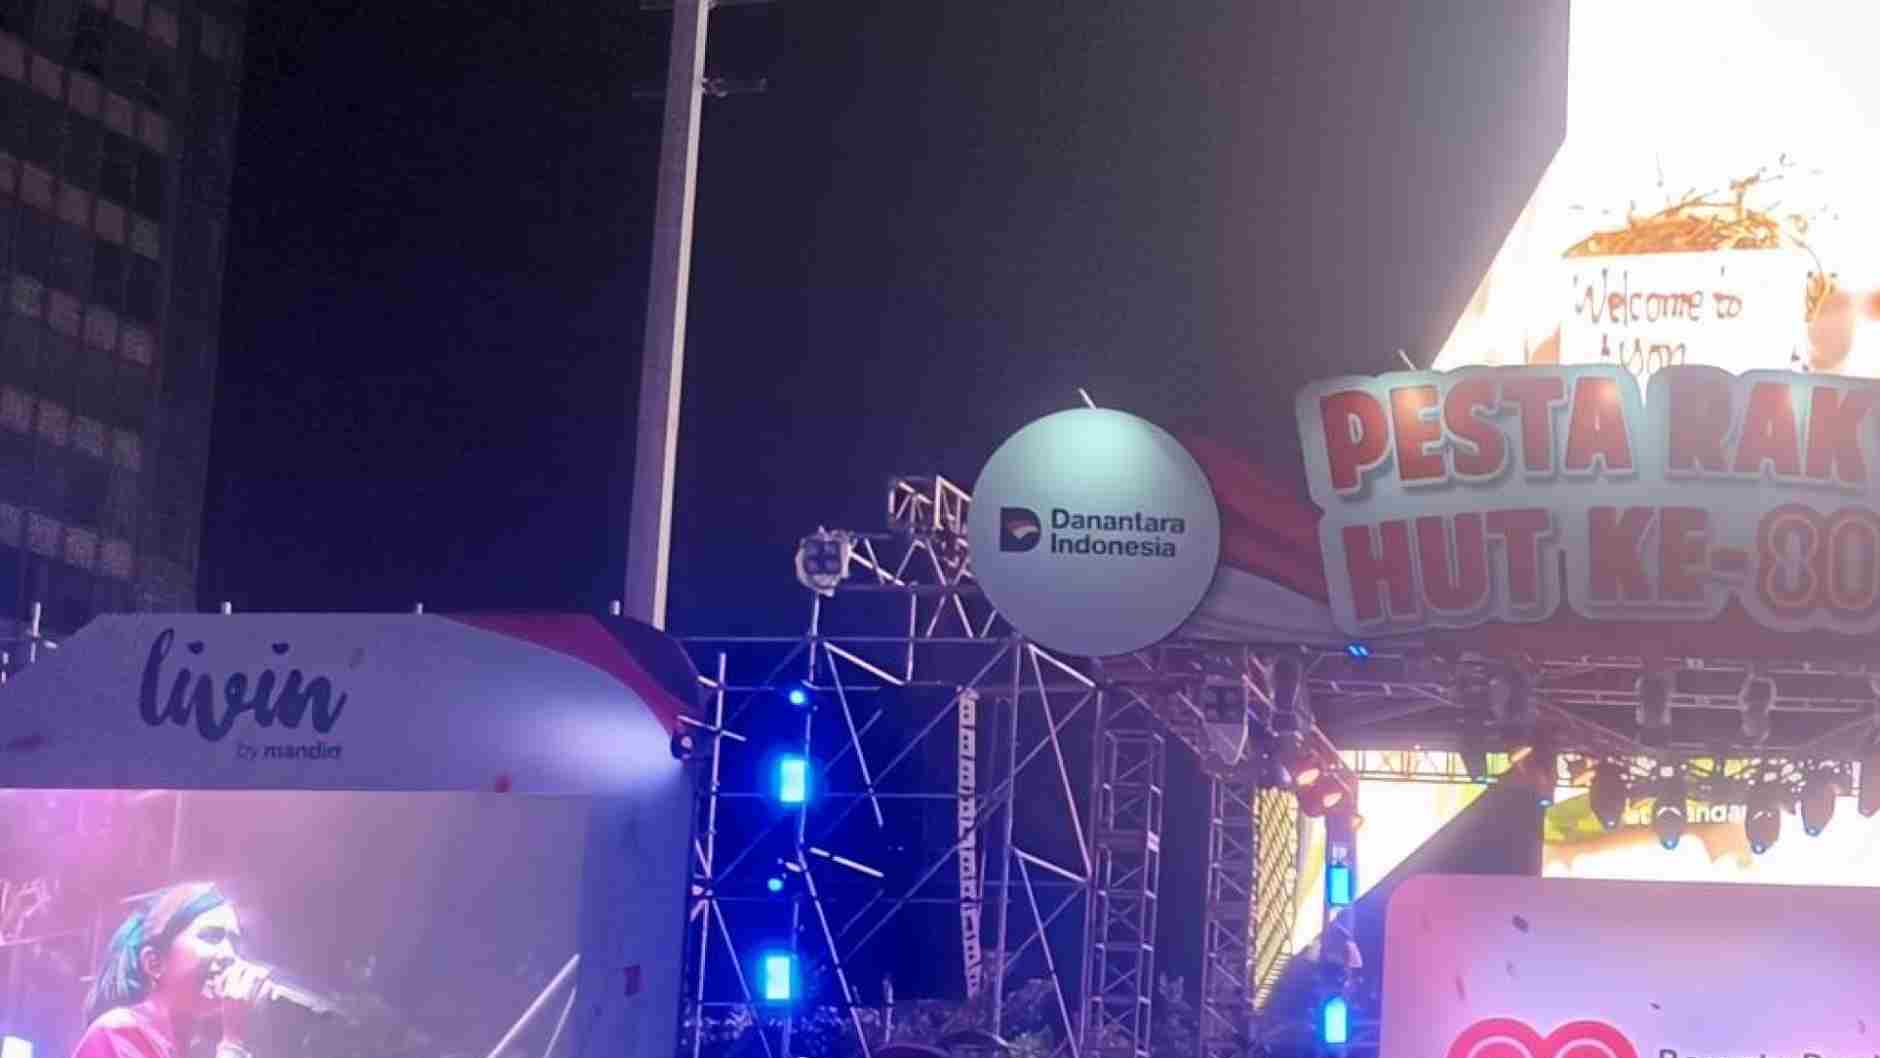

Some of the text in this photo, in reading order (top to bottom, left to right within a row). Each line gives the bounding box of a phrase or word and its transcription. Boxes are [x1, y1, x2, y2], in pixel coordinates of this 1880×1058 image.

[1572, 267, 1743, 327] Welcome to
[1320, 375, 1634, 494] PESTA
[1050, 508, 1186, 535] Danantara
[1050, 533, 1177, 558] Indonesia
[1341, 508, 1552, 622] HUT
[139, 627, 348, 742] livin
